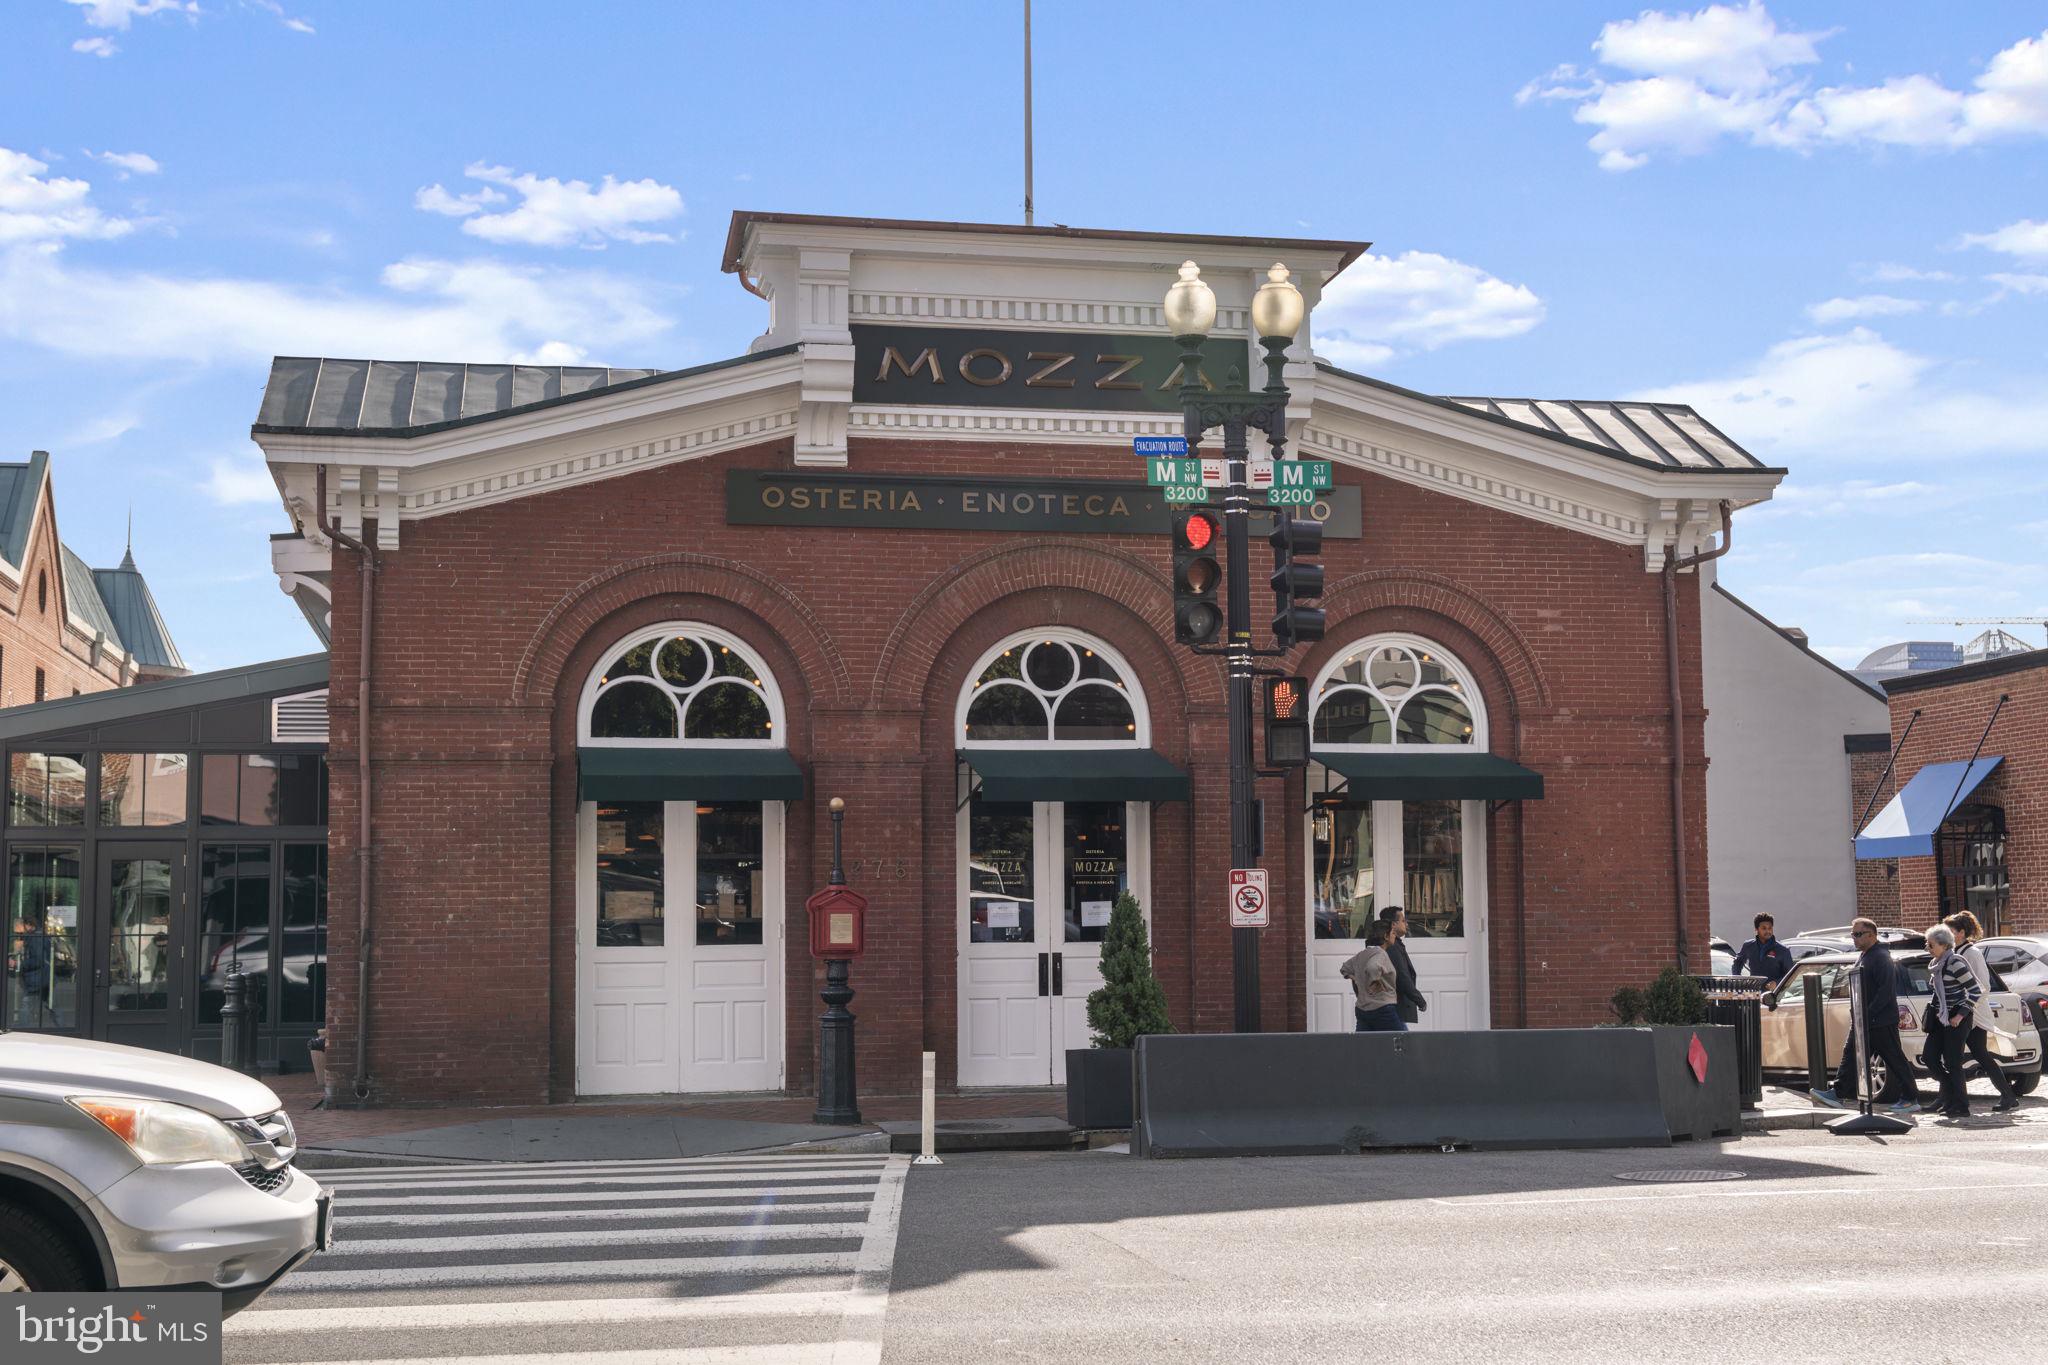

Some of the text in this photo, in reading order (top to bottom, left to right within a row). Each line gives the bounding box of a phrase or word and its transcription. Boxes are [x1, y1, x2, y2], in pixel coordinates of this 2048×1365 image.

[874, 347, 1215, 391] MOZZA
[1136, 441, 1185, 451] EVACUATION ROUTE
[1156, 461, 1196, 482] M ST
[1184, 473, 1197, 482] NW
[1283, 465, 1326, 485] M ST
[1312, 476, 1326, 485] NW
[1166, 486, 1207, 501] 3200
[1270, 488, 1314, 503] 3200
[761, 486, 1130, 516] OSTERIA ENOTECA
[981, 861, 1021, 872] MOZZA
[1075, 861, 1115, 872] MOZZA
[1234, 873, 1243, 882] NO
